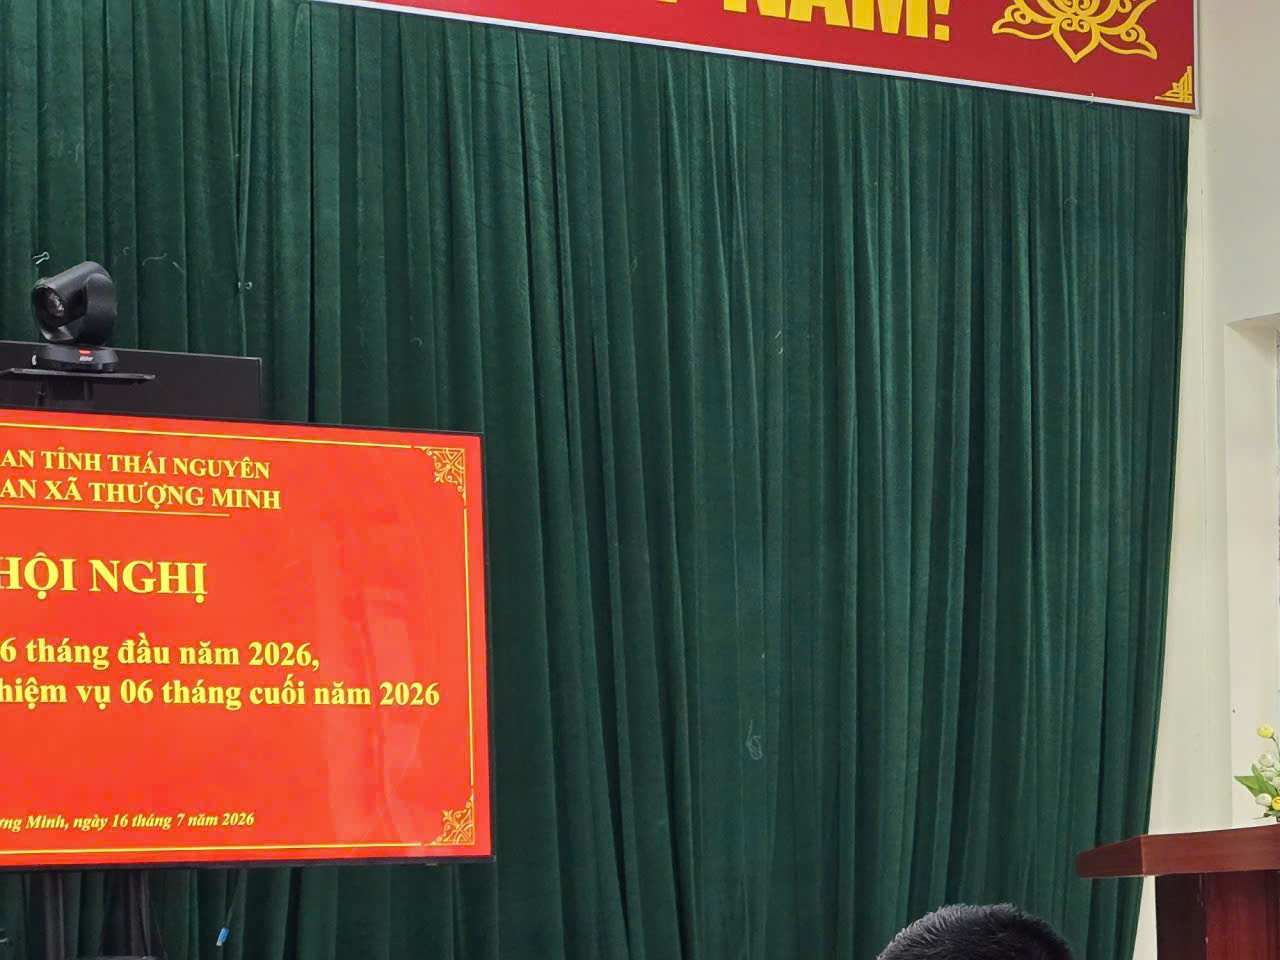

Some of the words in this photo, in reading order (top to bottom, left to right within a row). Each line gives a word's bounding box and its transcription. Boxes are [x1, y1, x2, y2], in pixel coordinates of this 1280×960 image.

[0, 449, 35, 468] AN
[41, 446, 102, 471] TỈNH
[107, 451, 166, 474] THÁI
[172, 456, 271, 479] NGUYÊN
[0, 478, 37, 499] AN
[44, 476, 82, 501] XÃ
[88, 481, 205, 509] THƯỢNG
[211, 488, 281, 510] MINH
[0, 552, 78, 600] HỘI
[88, 559, 208, 604] NGHỊ
[25, 638, 109, 670] tháng
[117, 632, 170, 664] đầu
[179, 641, 240, 665] năm
[248, 641, 319, 671] 2026,
[76, 684, 111, 710] vụ
[120, 679, 153, 704] 06
[161, 679, 242, 711] tháng
[249, 674, 306, 705] cuối
[313, 682, 371, 705] năm
[379, 682, 440, 706] 2026
[25, 814, 69, 831] Minh,
[73, 814, 108, 832] ngày
[112, 814, 129, 828] 16
[131, 814, 173, 831] tháng
[177, 813, 185, 827] 7
[187, 813, 218, 827] năm
[221, 812, 255, 827] 2026
